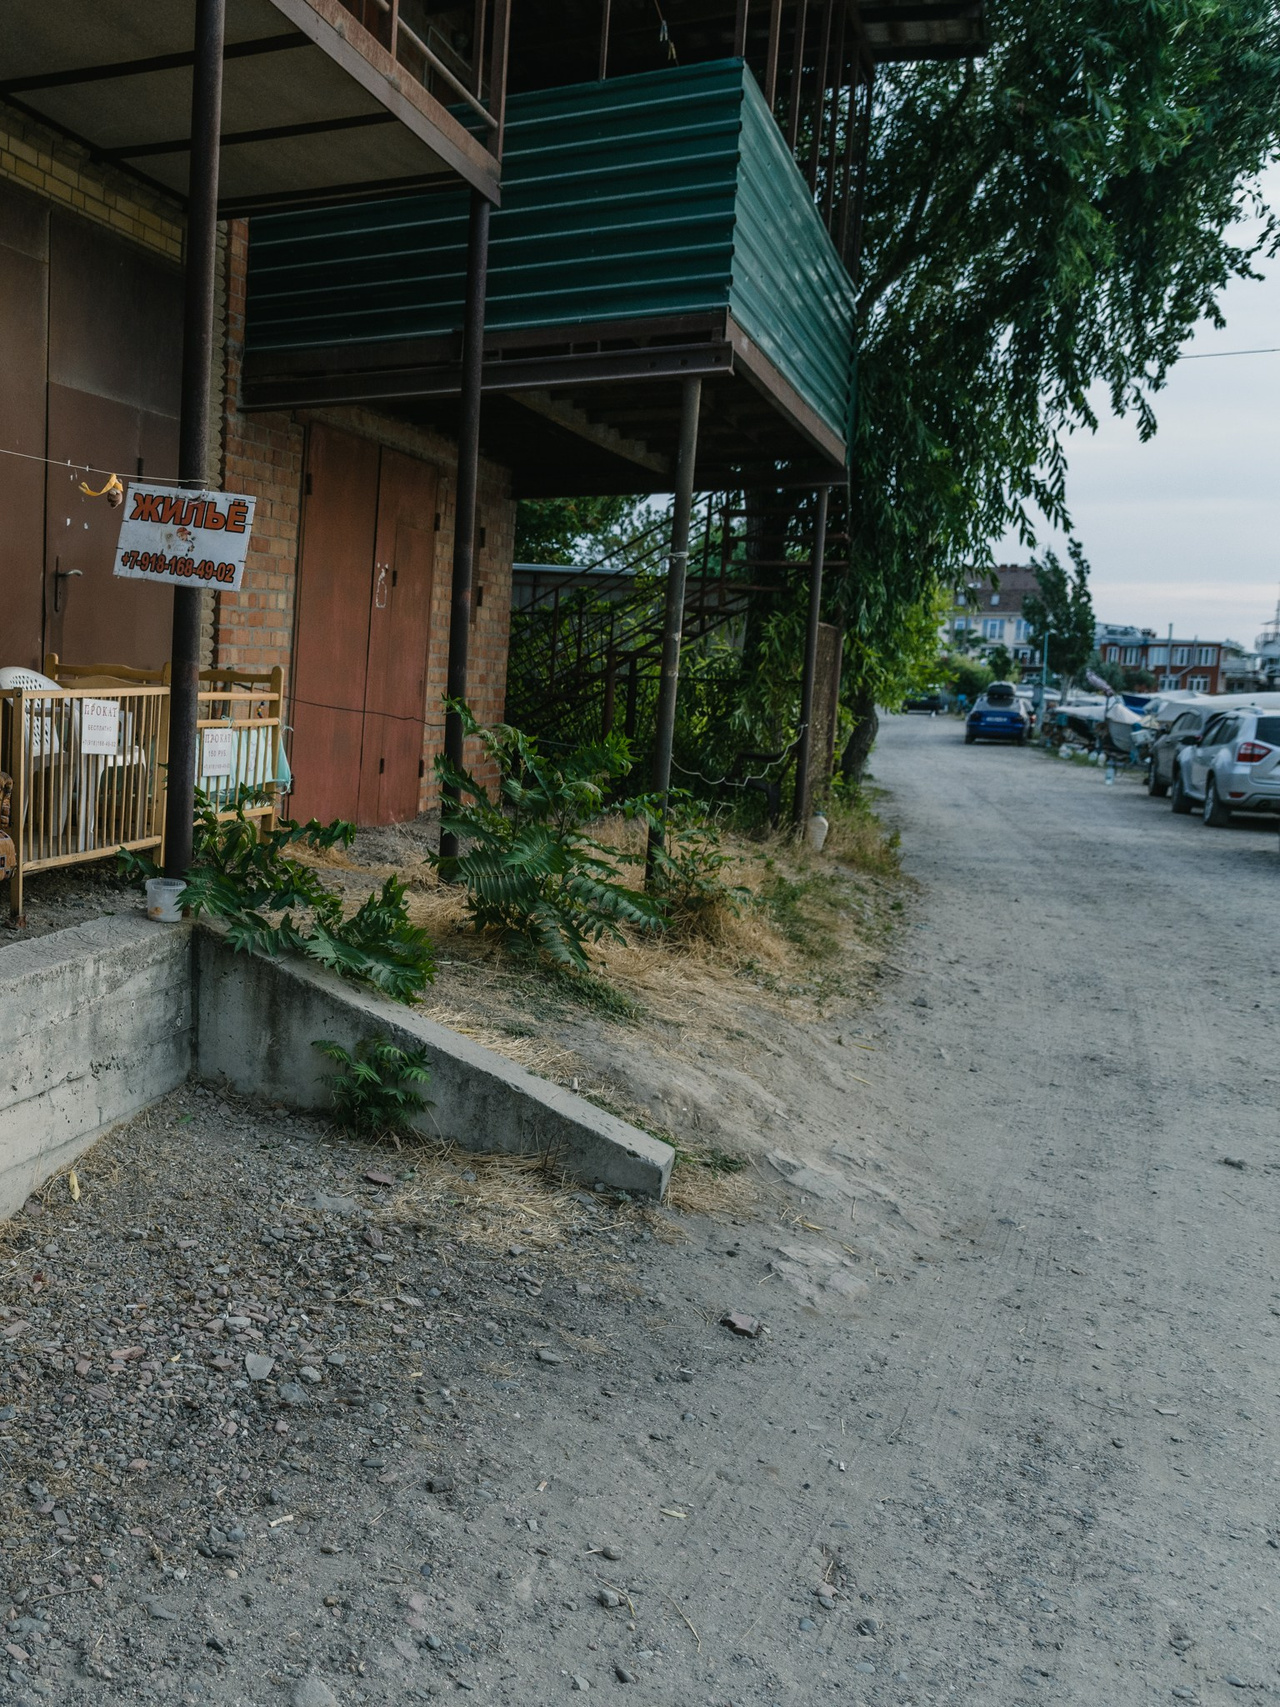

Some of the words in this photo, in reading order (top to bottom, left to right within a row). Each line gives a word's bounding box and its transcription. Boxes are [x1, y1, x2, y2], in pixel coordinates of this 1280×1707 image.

[130, 492, 249, 533] ЖИЛЬЁ
[121, 550, 236, 583] +7-918-168-49-02
[84, 703, 118, 718] ПРОКАТ
